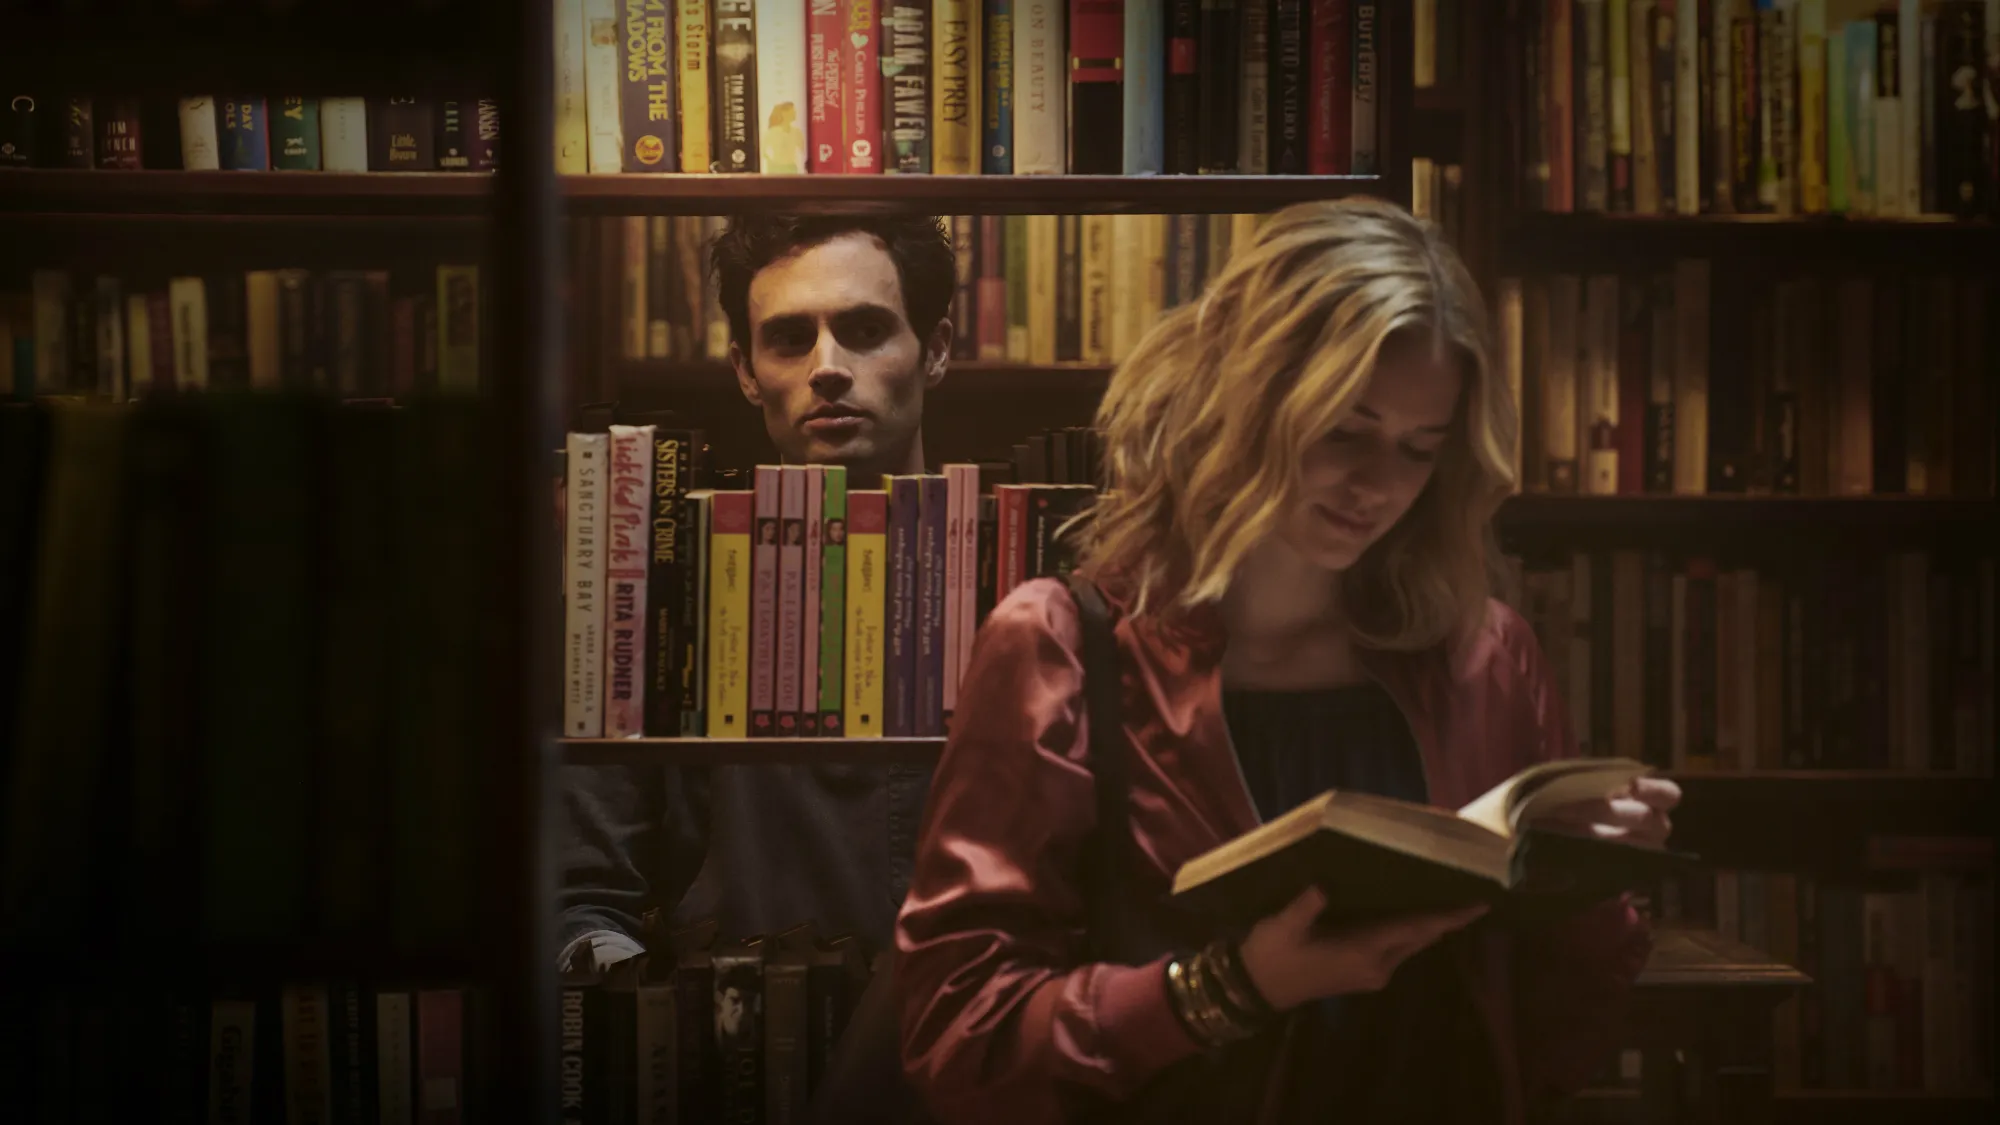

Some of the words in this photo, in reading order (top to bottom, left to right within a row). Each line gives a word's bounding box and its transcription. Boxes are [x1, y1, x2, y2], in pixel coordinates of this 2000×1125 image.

[893, 5, 926, 66] ADAM
[1031, 4, 1044, 29] ON
[647, 16, 667, 77] FROM
[686, 24, 704, 71] Storm
[944, 20, 968, 70] EASY
[1356, 5, 1377, 103] BUTTERFLY
[647, 80, 669, 122] THE
[730, 74, 746, 96] TIM
[943, 73, 968, 128] PREY
[1031, 40, 1045, 114] BEAUTY
[241, 104, 253, 130] DAY
[893, 75, 926, 141] FAWER
[653, 439, 679, 497] SISTERS
[576, 468, 595, 569] SANCTUARY
[658, 499, 673, 515] IN
[652, 518, 677, 565] CRIME
[576, 580, 593, 612] BAY
[614, 583, 635, 622] RITA
[612, 629, 634, 701] RUDNER
[782, 675, 795, 705] YOU
[561, 990, 584, 1051] ROBIN
[561, 1055, 584, 1109] COOK
